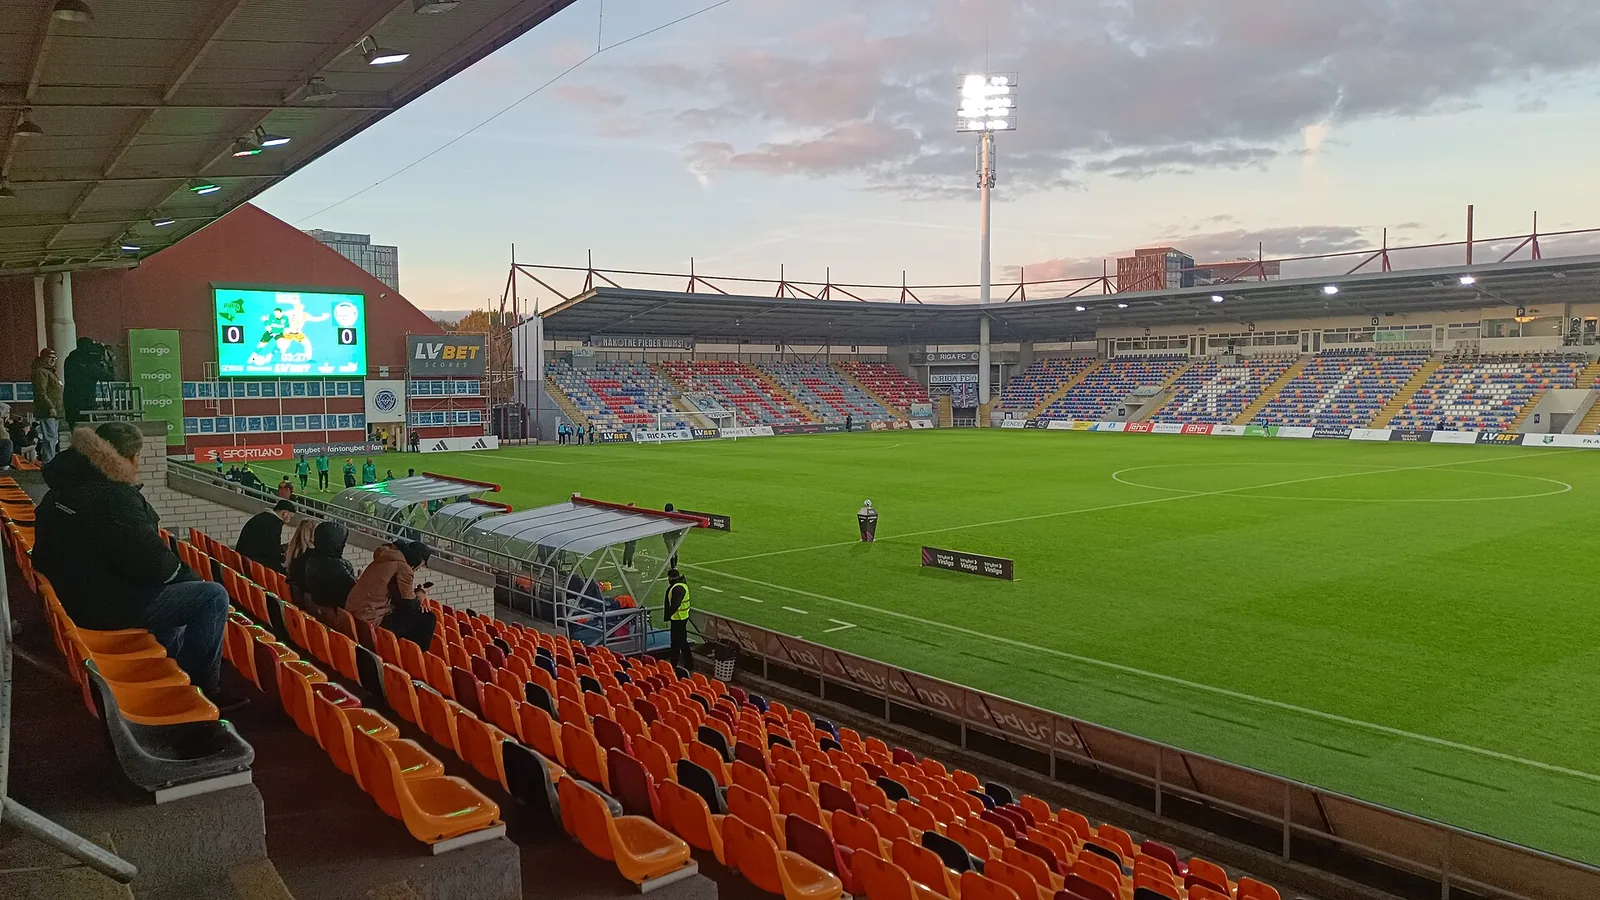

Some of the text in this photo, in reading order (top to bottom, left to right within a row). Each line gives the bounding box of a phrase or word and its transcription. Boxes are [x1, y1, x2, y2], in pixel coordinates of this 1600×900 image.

[227, 326, 240, 343] 0
[341, 328, 353, 344] 0
[139, 347, 170, 356] mogo
[140, 372, 171, 382] mogo
[142, 398, 173, 408] mogo
[646, 432, 667, 440] RIGA
[1481, 432, 1520, 441] LVBET
[223, 447, 283, 459] SPORTLAND
[293, 446, 321, 455] tonybet
[937, 558, 955, 567] Virsliga
[960, 562, 978, 571] Virsliga
[984, 566, 1003, 575] Virsliga
